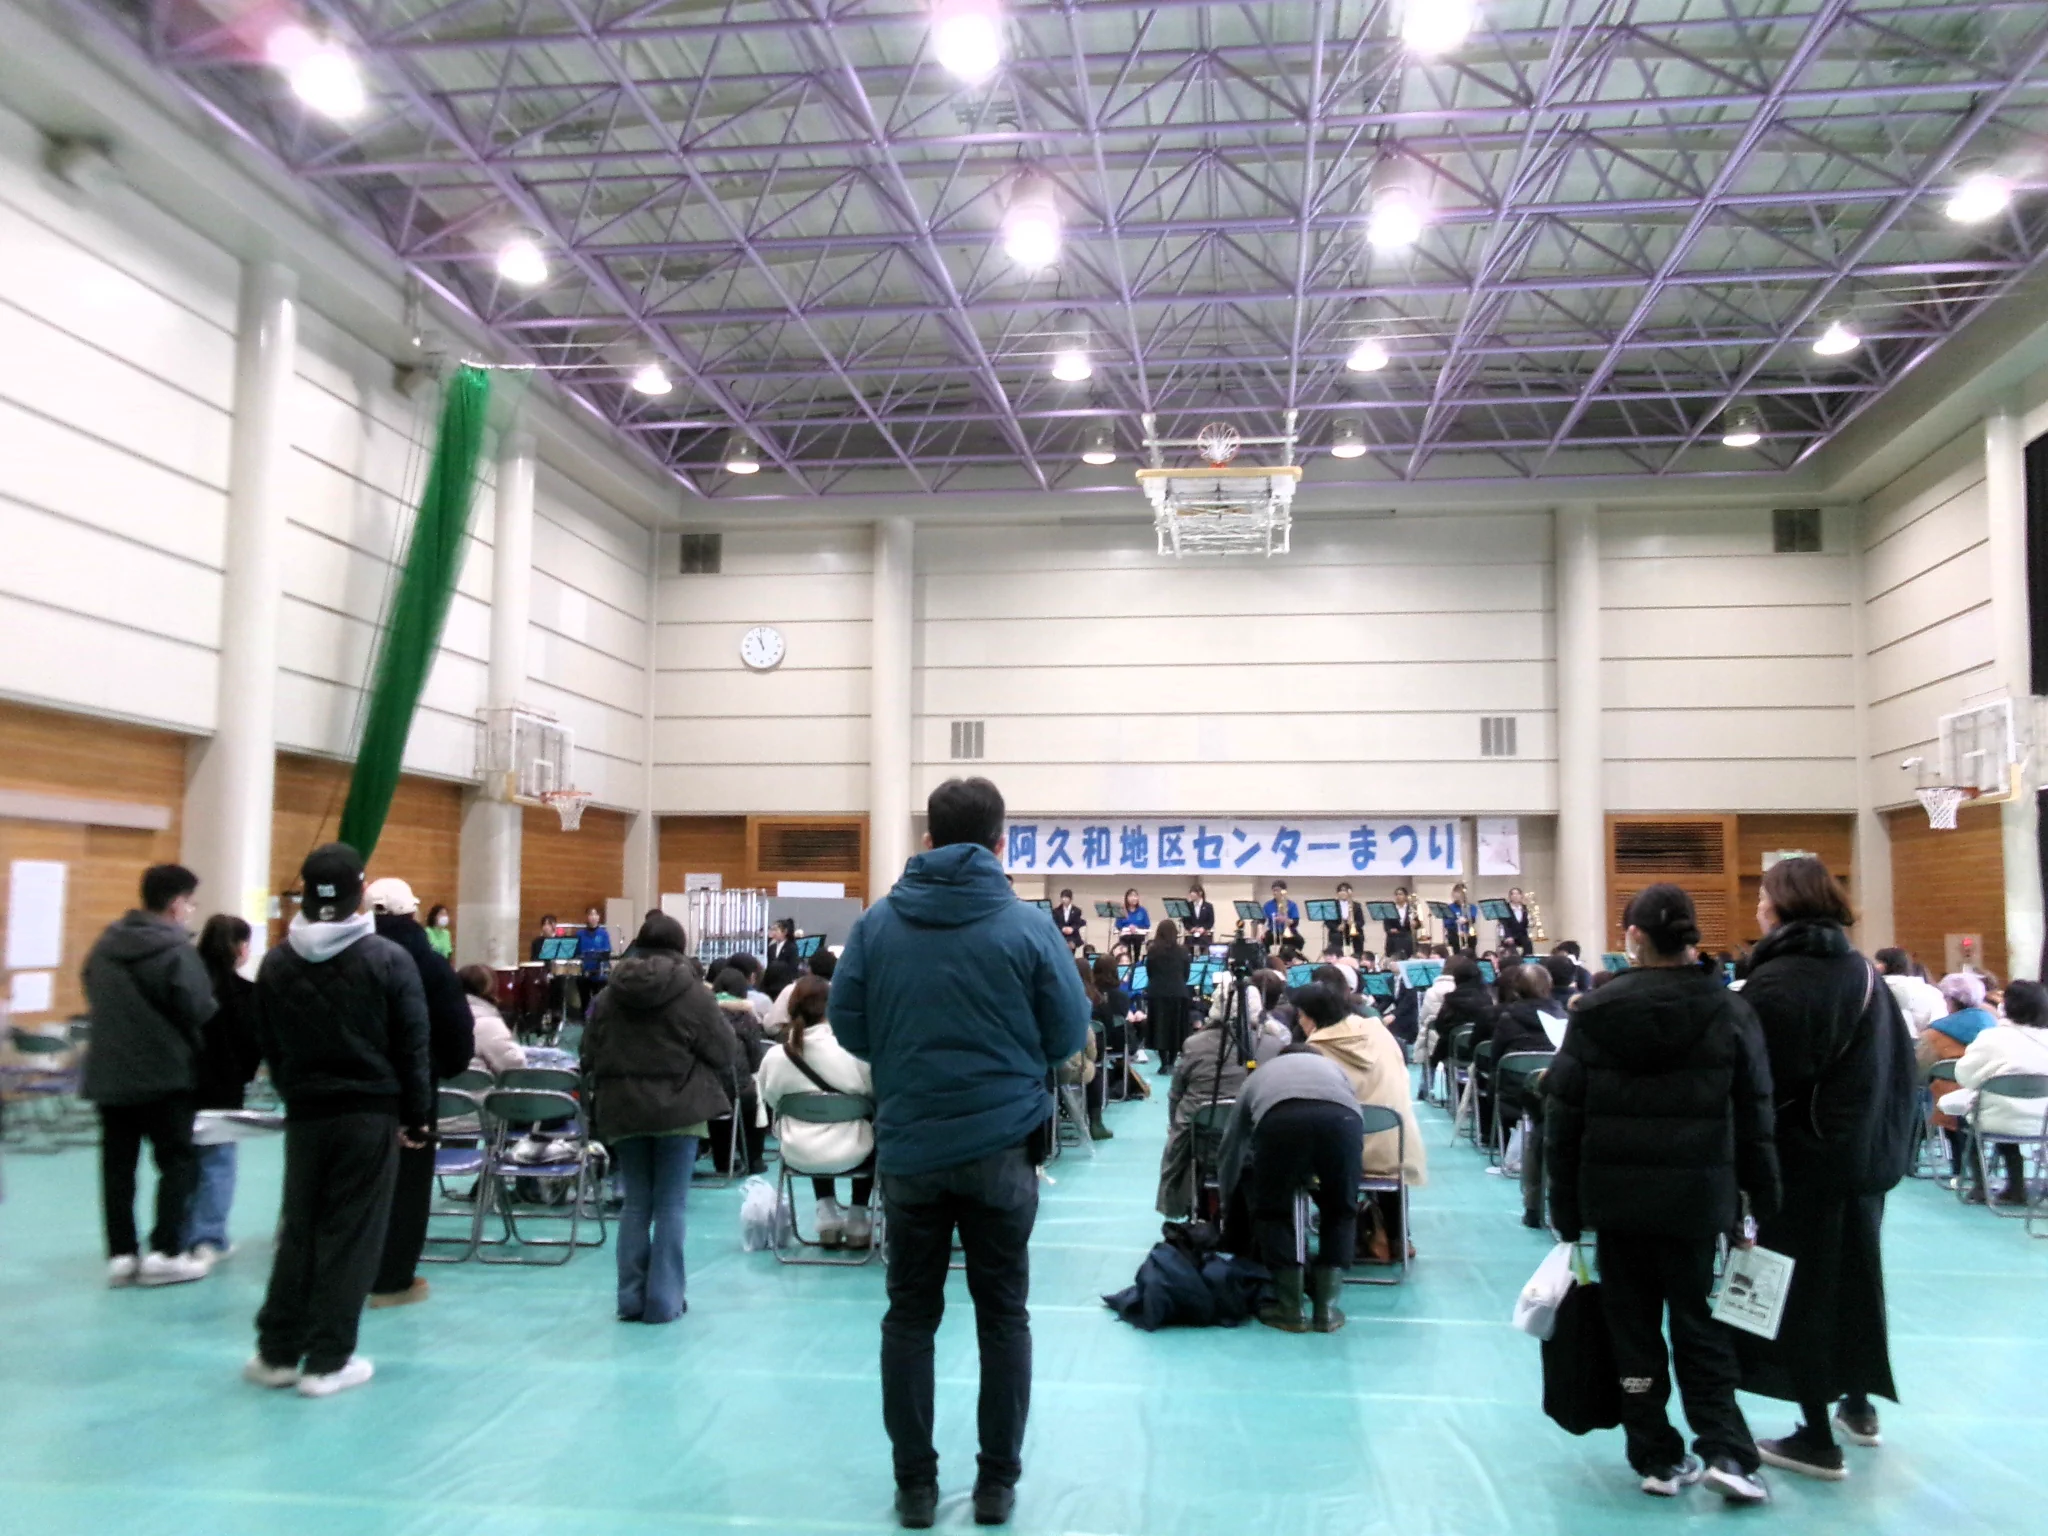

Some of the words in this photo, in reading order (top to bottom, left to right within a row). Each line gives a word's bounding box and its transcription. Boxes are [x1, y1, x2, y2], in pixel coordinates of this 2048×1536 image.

[1008, 823, 1454, 870] 阿久和地区センターまつり
